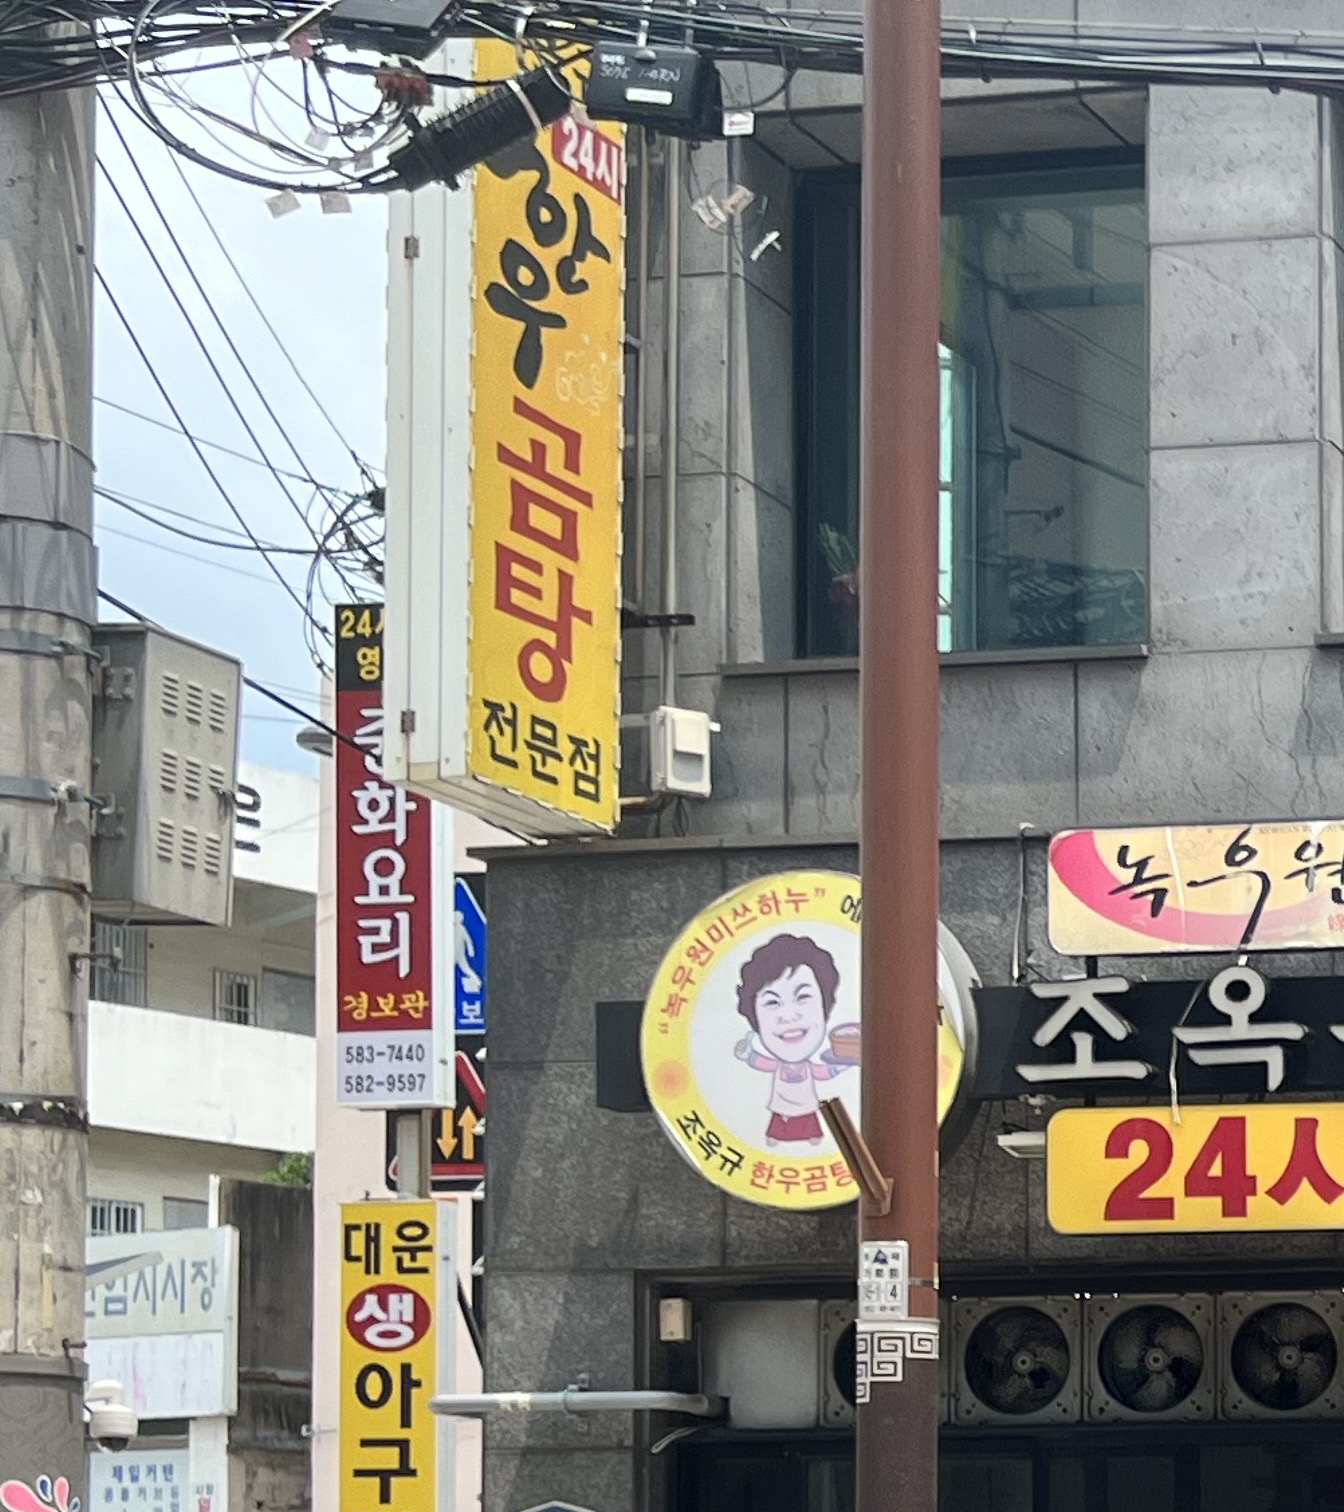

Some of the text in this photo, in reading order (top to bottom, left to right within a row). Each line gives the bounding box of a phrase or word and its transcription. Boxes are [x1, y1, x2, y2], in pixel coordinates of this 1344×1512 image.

[560, 115, 621, 198] 24시
[339, 609, 384, 641] 24
[483, 697, 603, 804] 전문점
[342, 990, 429, 1021] 경보관
[344, 1044, 426, 1066] 583-7440
[344, 1074, 426, 1095] 582-9597
[676, 1109, 745, 1177] 조옥규
[343, 1219, 434, 1276] 대운
